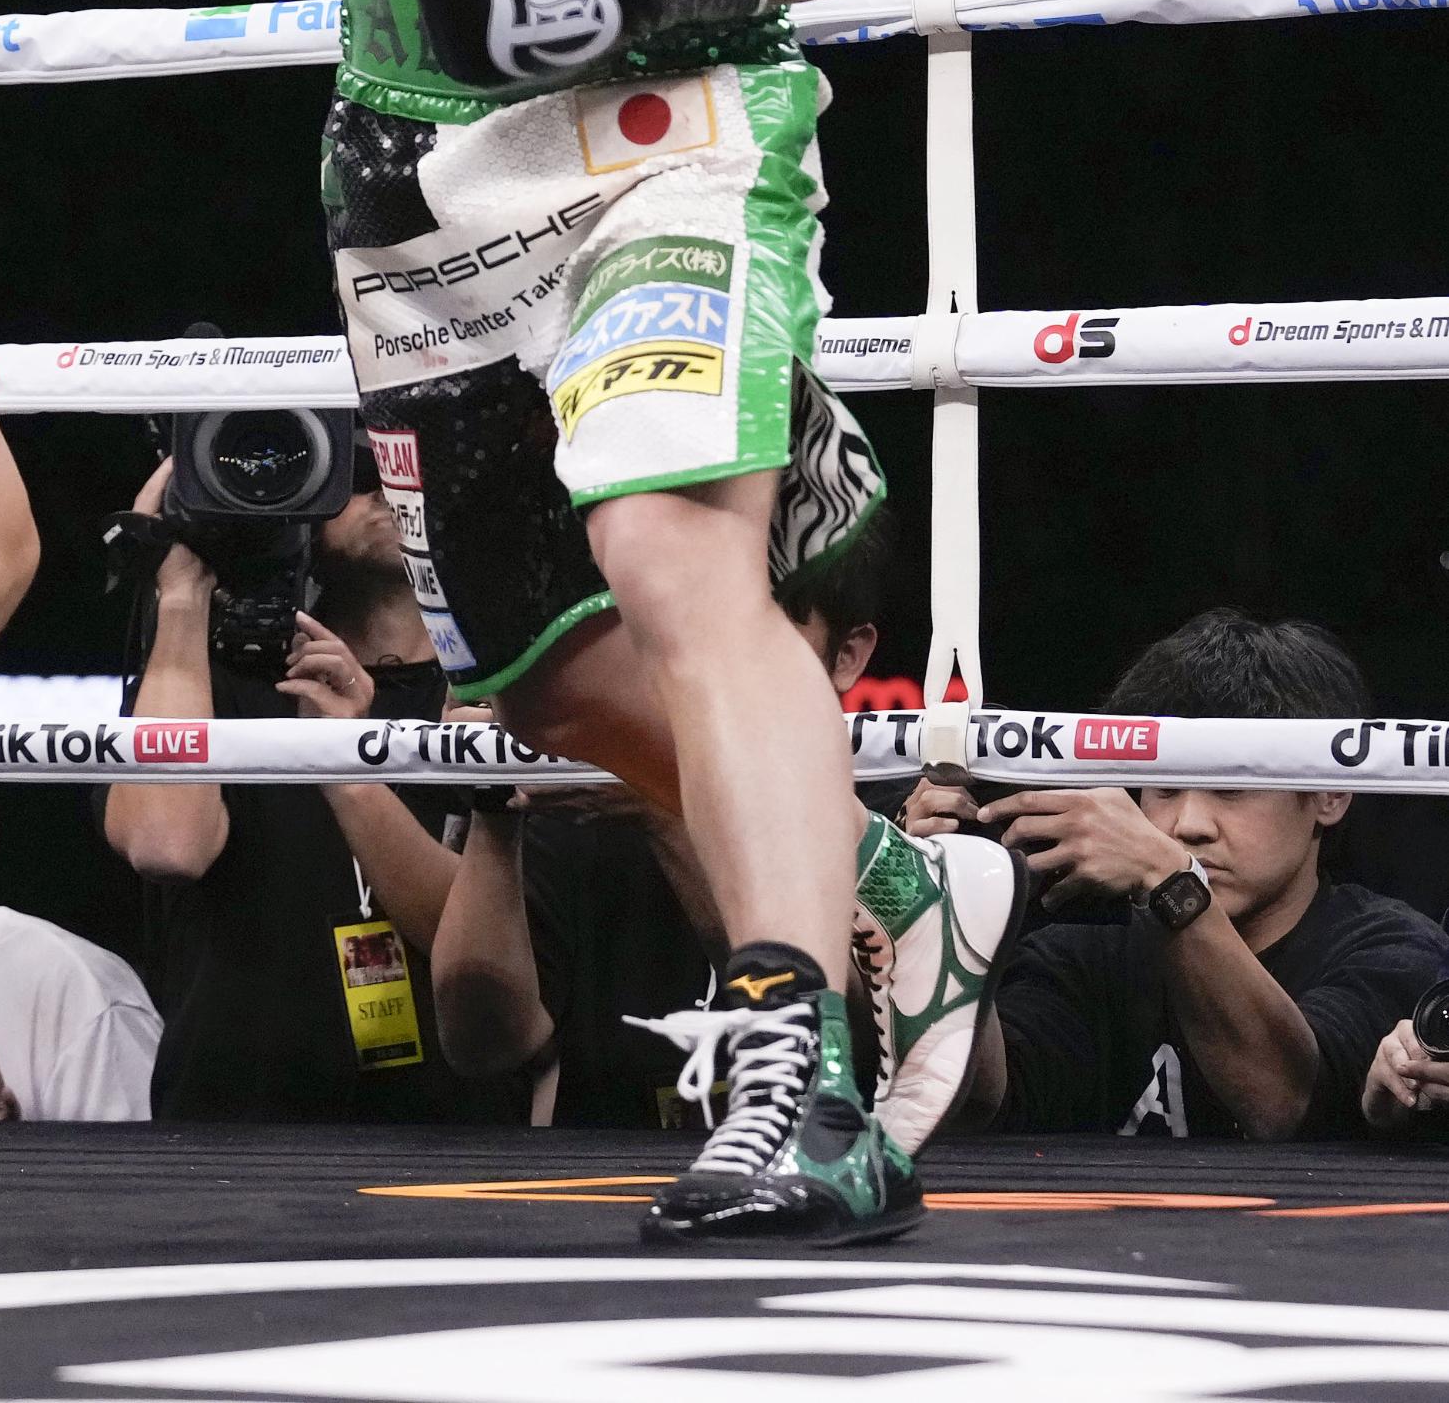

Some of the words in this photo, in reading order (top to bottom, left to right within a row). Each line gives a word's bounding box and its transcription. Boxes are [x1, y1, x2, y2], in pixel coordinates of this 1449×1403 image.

[352, 192, 605, 301] PORSCHE
[375, 325, 449, 359] Porsche
[450, 306, 516, 341] Center
[1255, 321, 1329, 342] Dream
[1333, 319, 1407, 344] Sports
[1409, 317, 1424, 338] &
[80, 348, 143, 366] Dream
[145, 349, 206, 369] Sports
[222, 346, 343, 368] Management
[141, 730, 200, 755] LIVE
[1083, 725, 1150, 750] LIVE
[1396, 723, 1449, 767] Ti
[358, 997, 406, 1021] STAFF
